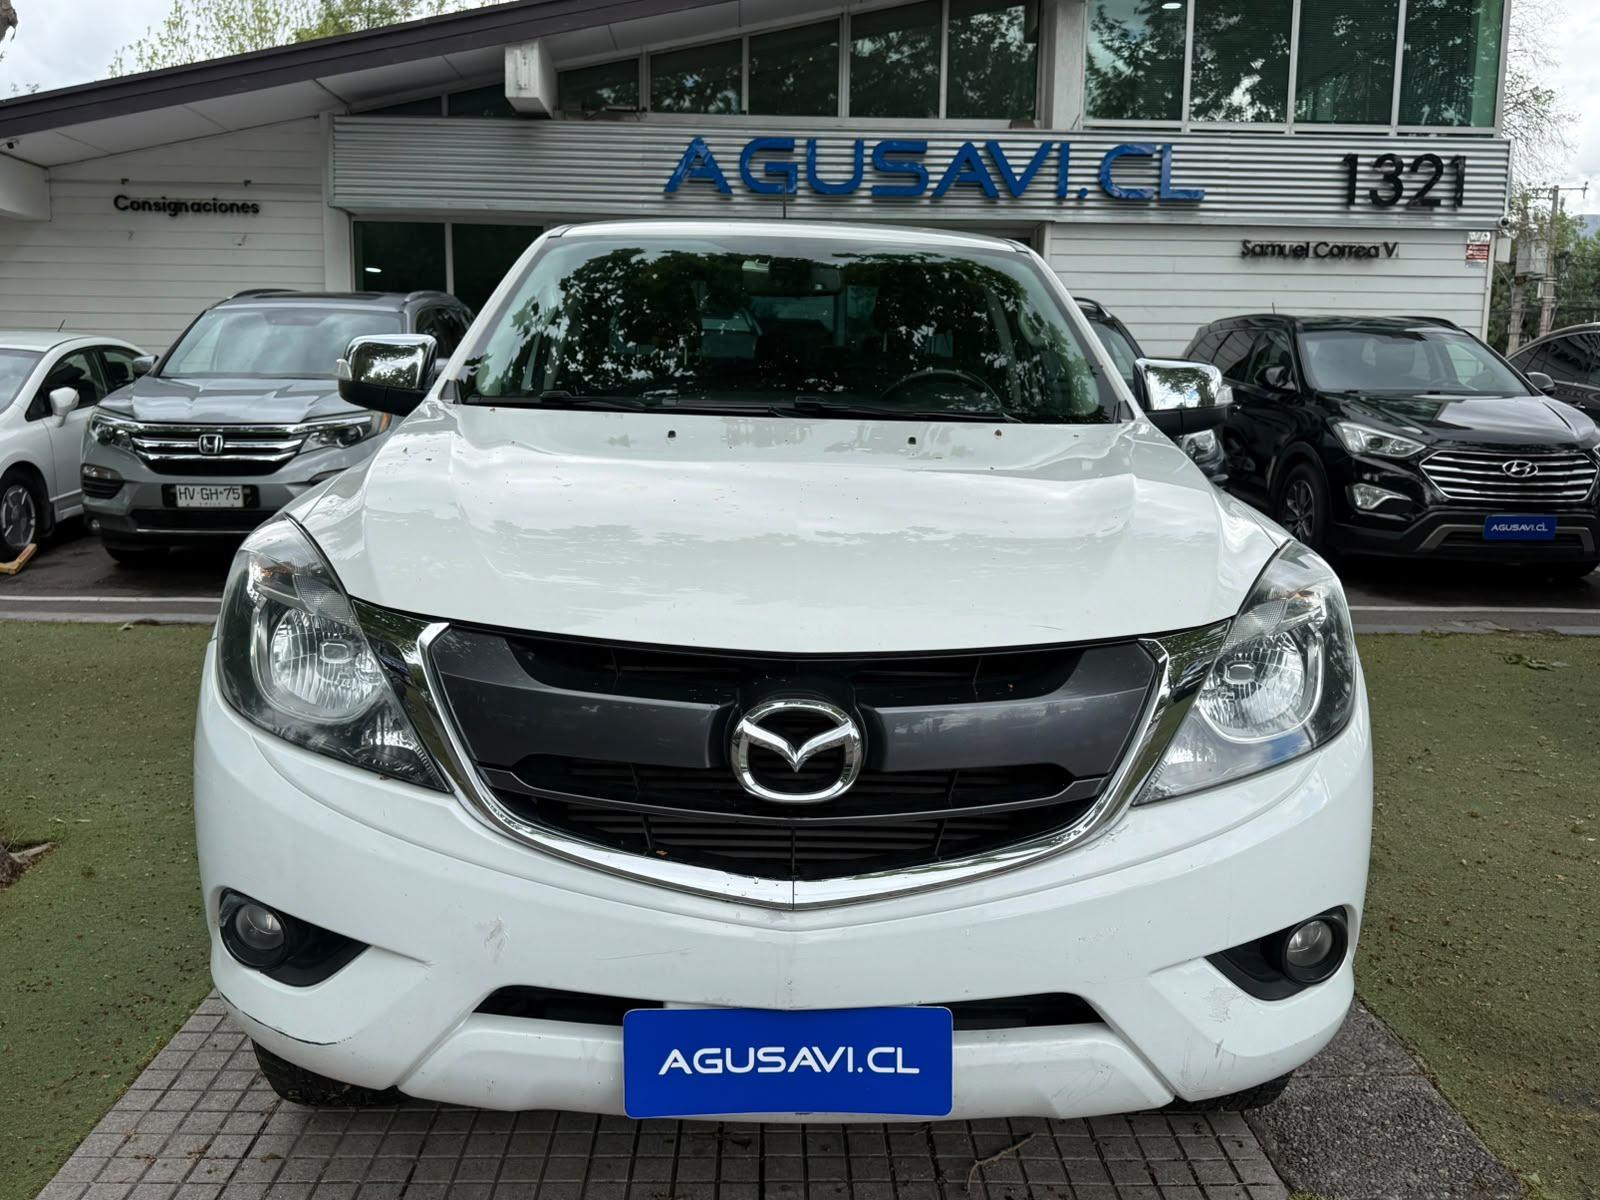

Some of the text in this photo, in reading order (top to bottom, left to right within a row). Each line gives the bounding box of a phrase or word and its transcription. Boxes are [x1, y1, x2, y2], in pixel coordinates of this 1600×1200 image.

[664, 135, 1205, 201] AGUSAVI.CL
[1341, 152, 1466, 209] 1321
[113, 195, 260, 217] Consignaciones
[1241, 239, 1310, 258] Samuel
[1314, 241, 1380, 258] Correa
[1490, 521, 1549, 532] AGUSAVI.CL
[658, 1046, 920, 1076] AGUSAVI.CL
